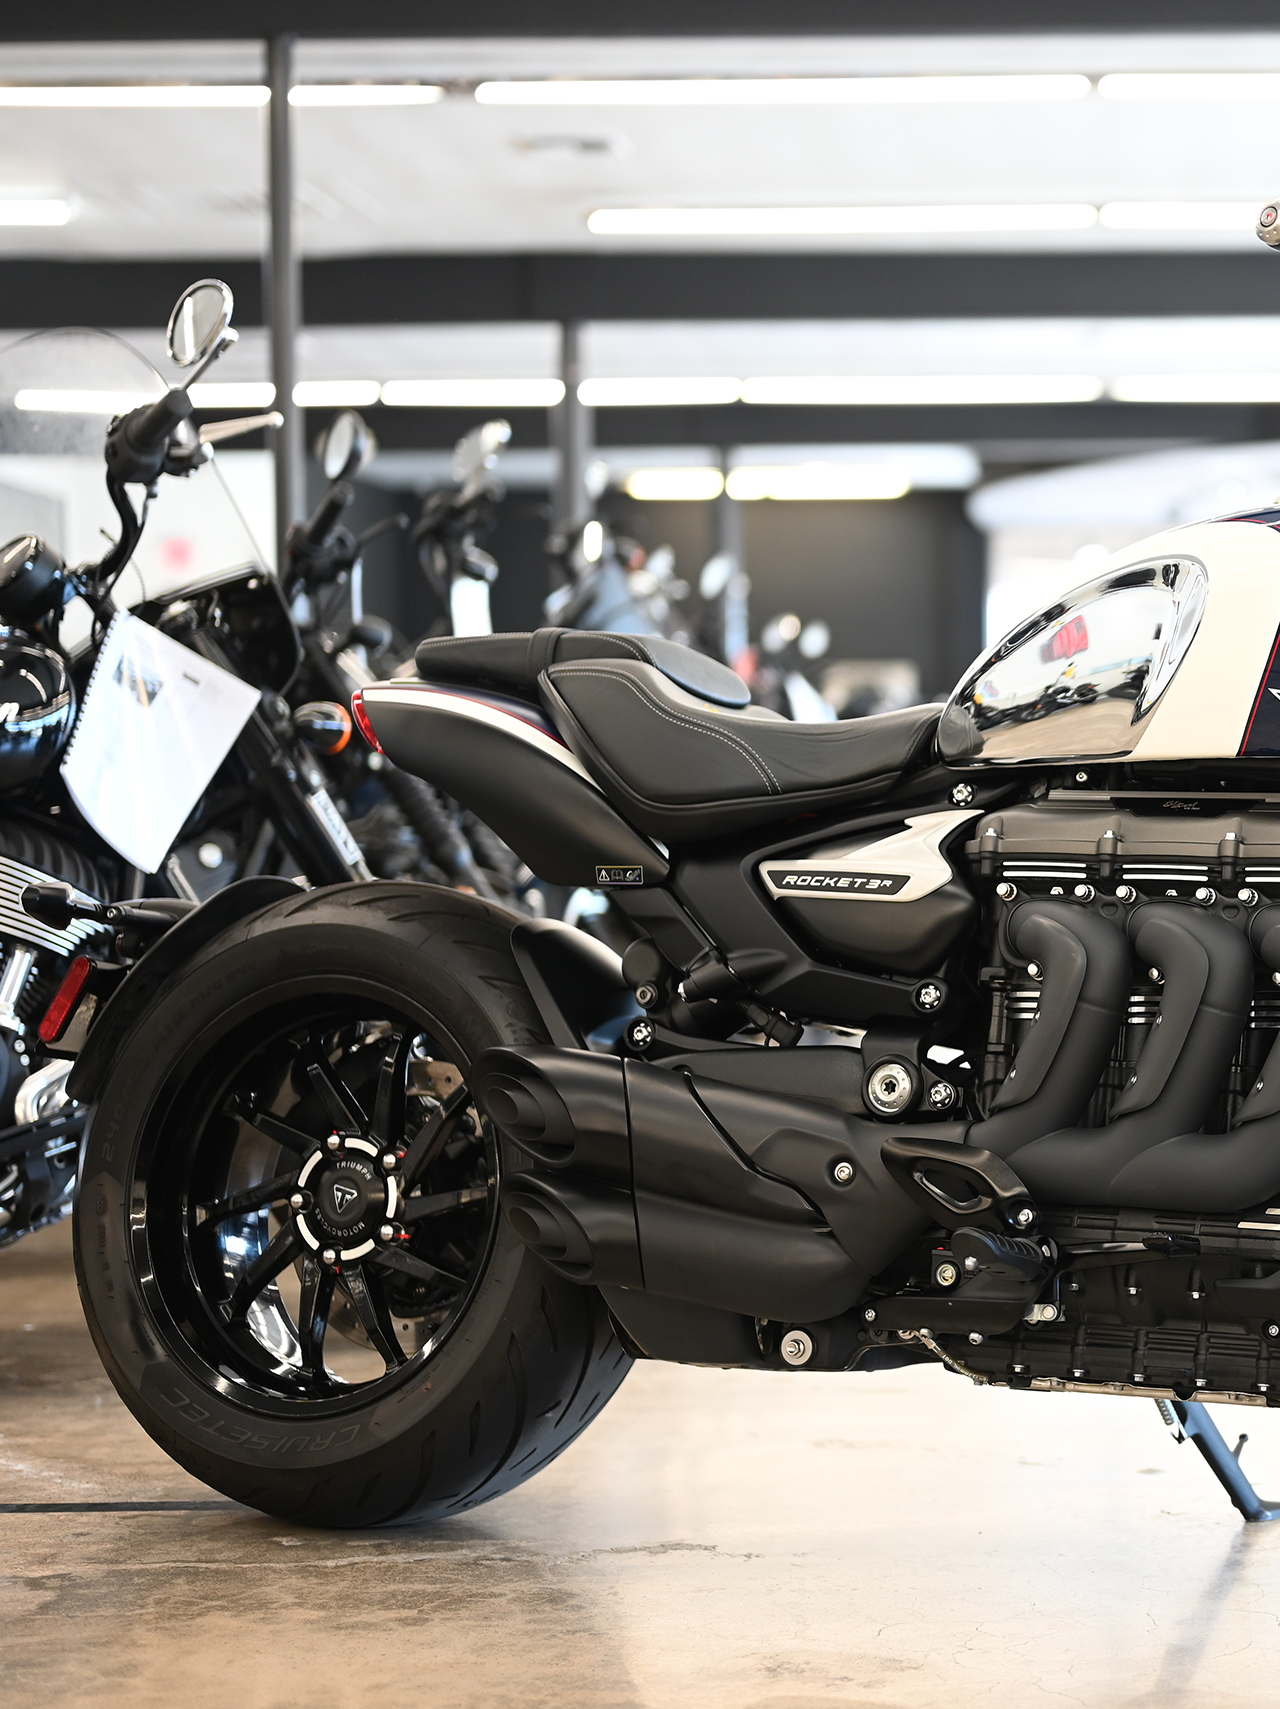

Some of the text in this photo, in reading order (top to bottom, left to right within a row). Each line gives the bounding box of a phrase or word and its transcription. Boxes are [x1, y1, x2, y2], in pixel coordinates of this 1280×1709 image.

[336, 1160, 372, 1181] TRIUMPH
[315, 1207, 366, 1237] MOTORCYCLES
[169, 1386, 362, 1454] CRUISETEC
